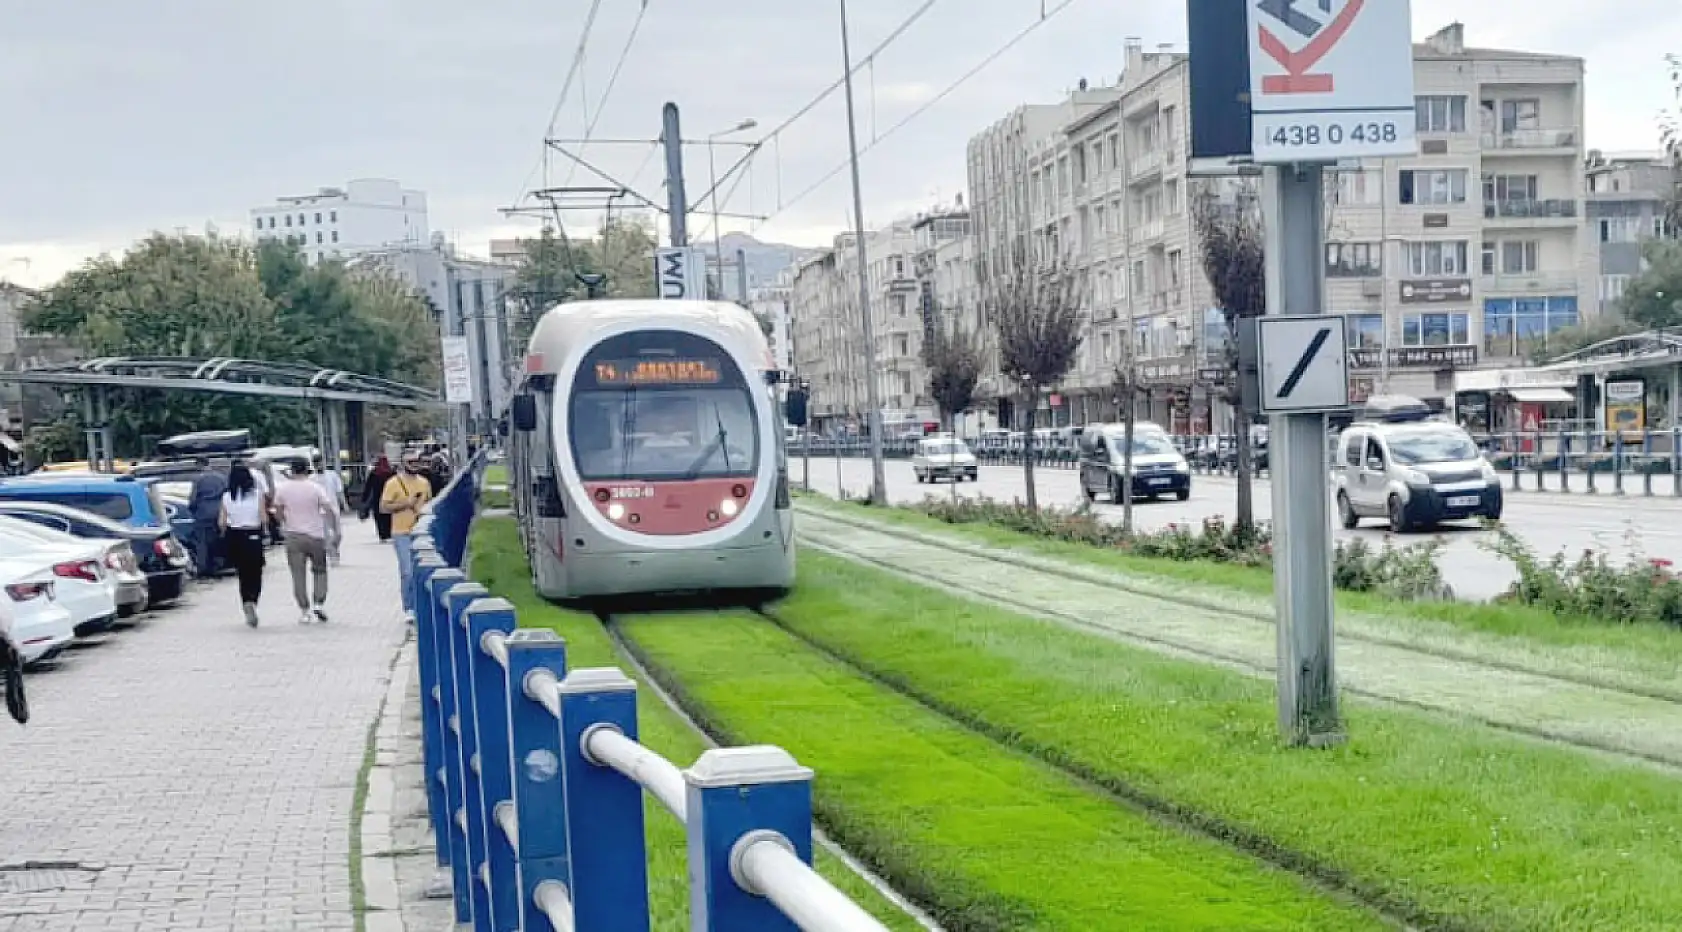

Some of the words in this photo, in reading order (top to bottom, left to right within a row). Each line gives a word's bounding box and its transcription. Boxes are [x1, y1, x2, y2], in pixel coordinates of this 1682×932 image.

[1272, 125, 1320, 145] 438
[1351, 122, 1397, 144] 438
[596, 364, 615, 381] T4
